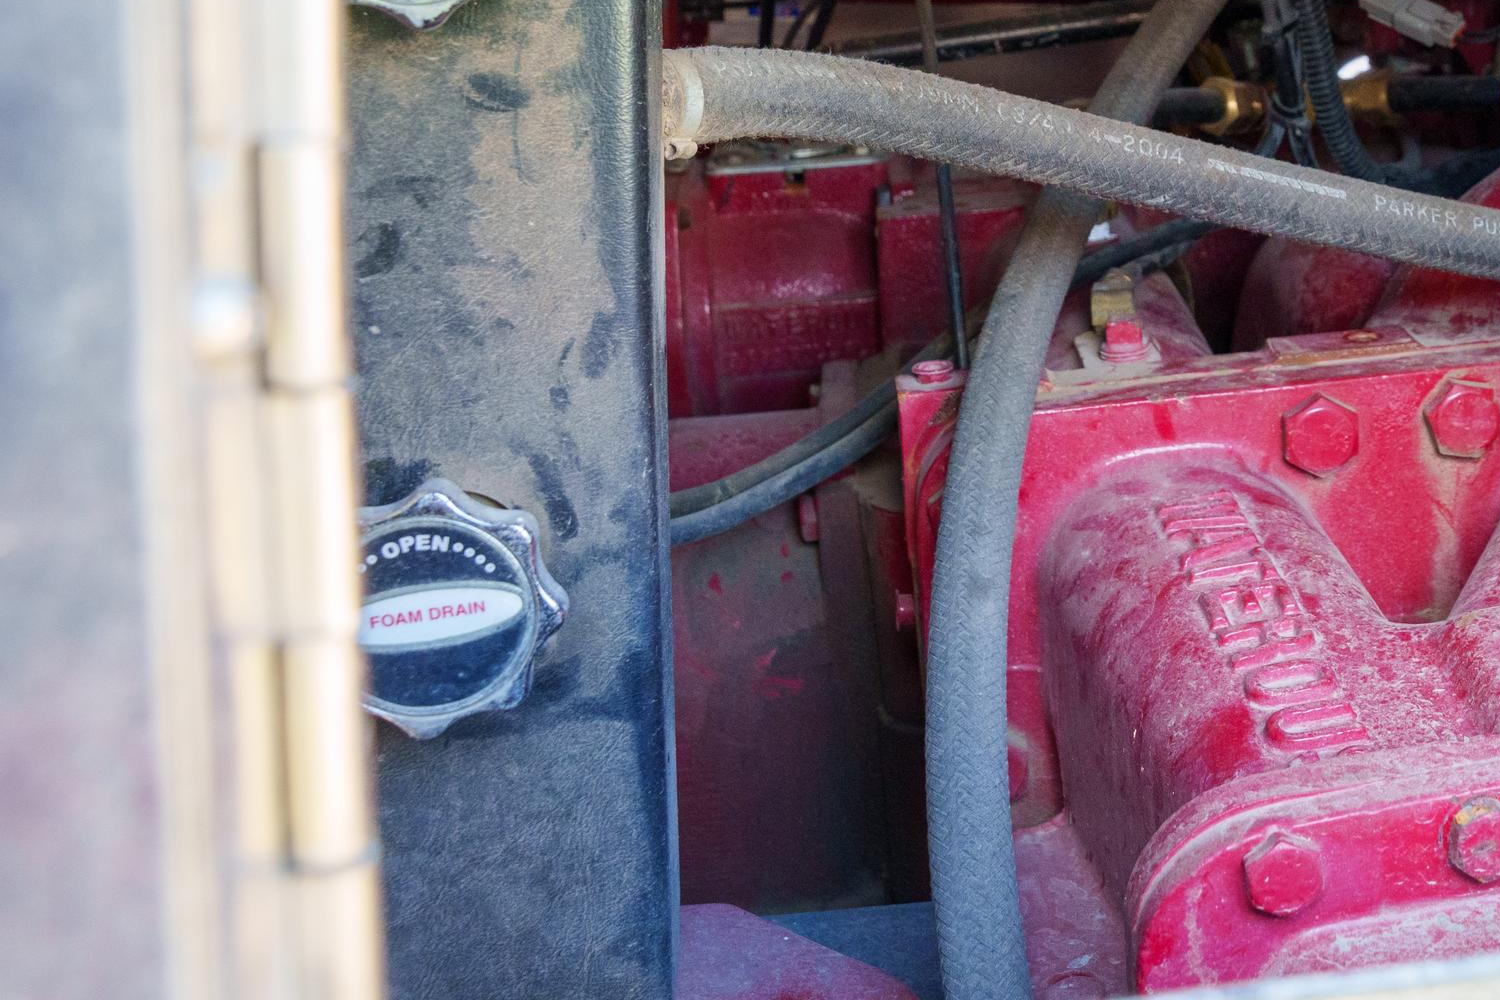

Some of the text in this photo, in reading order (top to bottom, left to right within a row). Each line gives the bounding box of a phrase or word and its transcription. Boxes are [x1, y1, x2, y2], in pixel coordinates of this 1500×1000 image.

[1374, 194, 1457, 228] PARKER
[381, 533, 450, 559] OPEN
[369, 600, 486, 629] FOAM DRAIN
[1157, 488, 1370, 763] WATEROU
